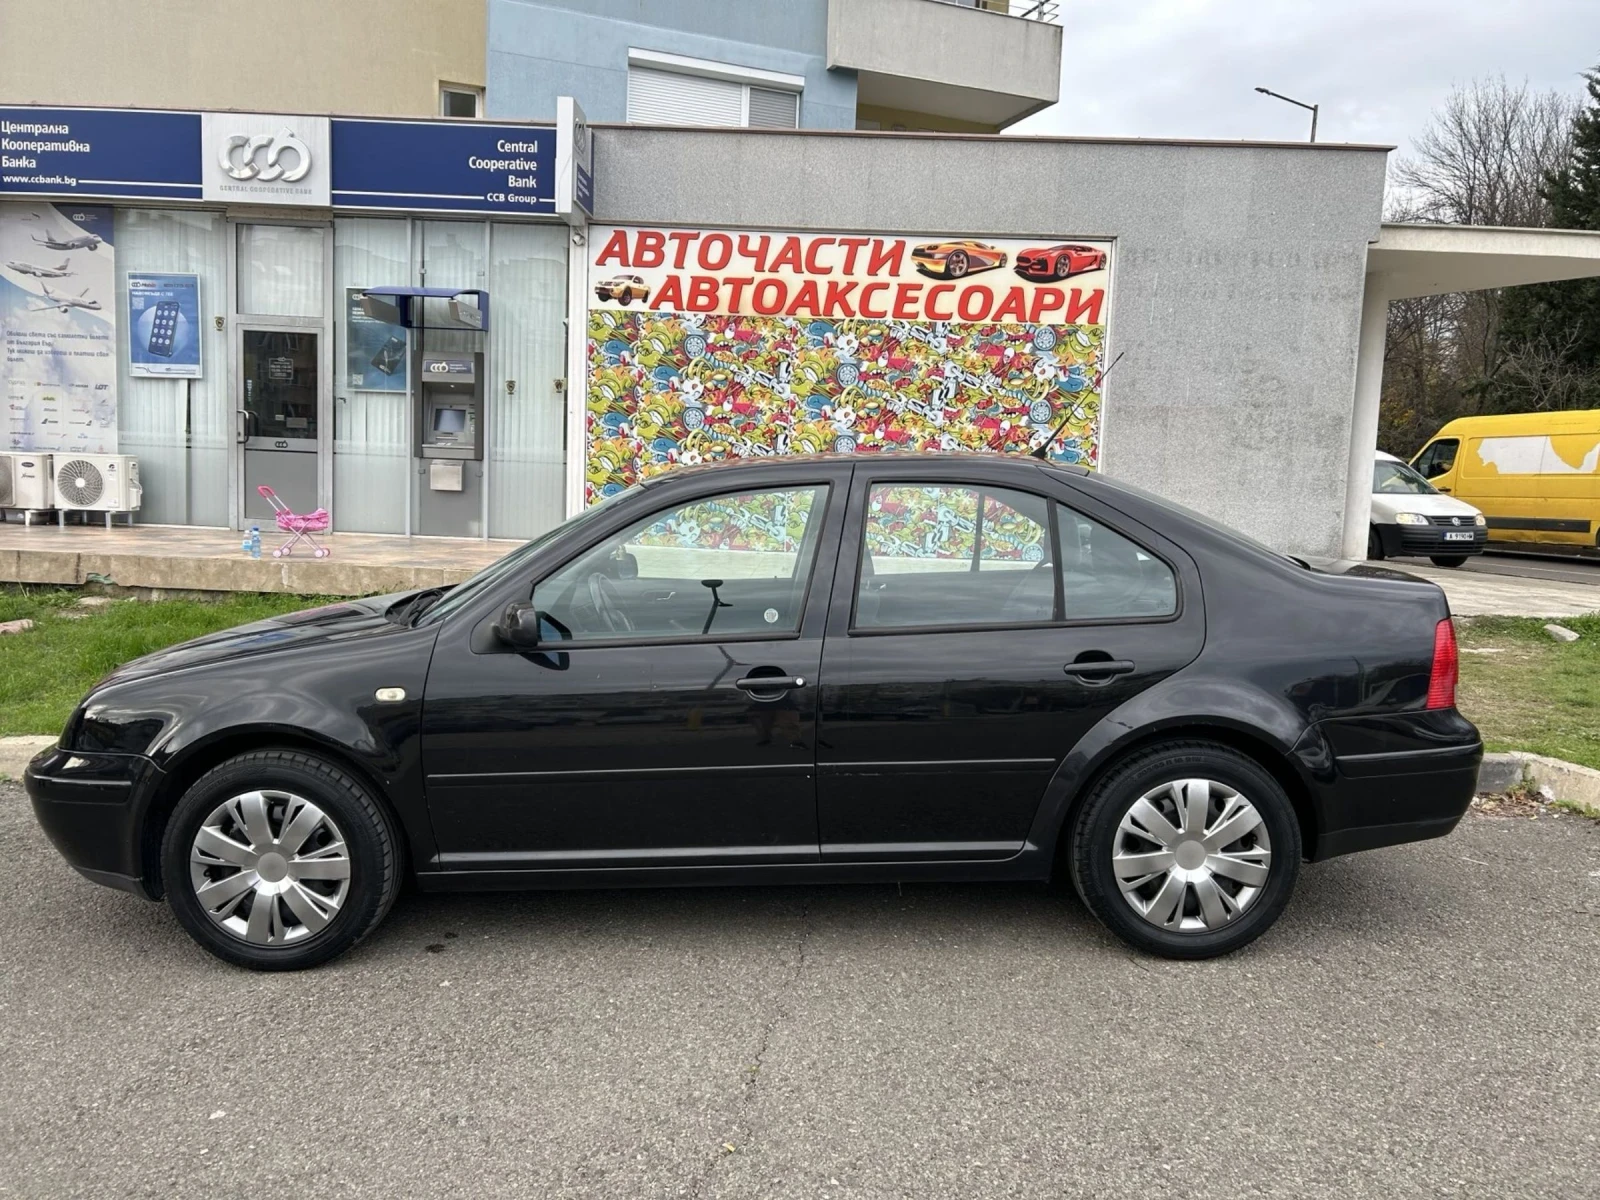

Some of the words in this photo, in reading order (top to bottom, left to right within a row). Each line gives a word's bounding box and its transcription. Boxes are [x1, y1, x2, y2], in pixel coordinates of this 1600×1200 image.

[1, 121, 69, 136] Централна
[1, 138, 90, 154] Кооперативна
[497, 139, 538, 153] Central
[2, 155, 36, 168] Банка
[468, 156, 537, 172] Cooperative
[2, 174, 77, 187] www.ccbank.bg
[508, 175, 537, 188] Bank
[486, 192, 505, 202] CCB
[507, 193, 537, 205] Group
[595, 229, 906, 277] АВТОЧАСТИ
[649, 274, 1105, 324] АВТОАКСЕСОАРИ
